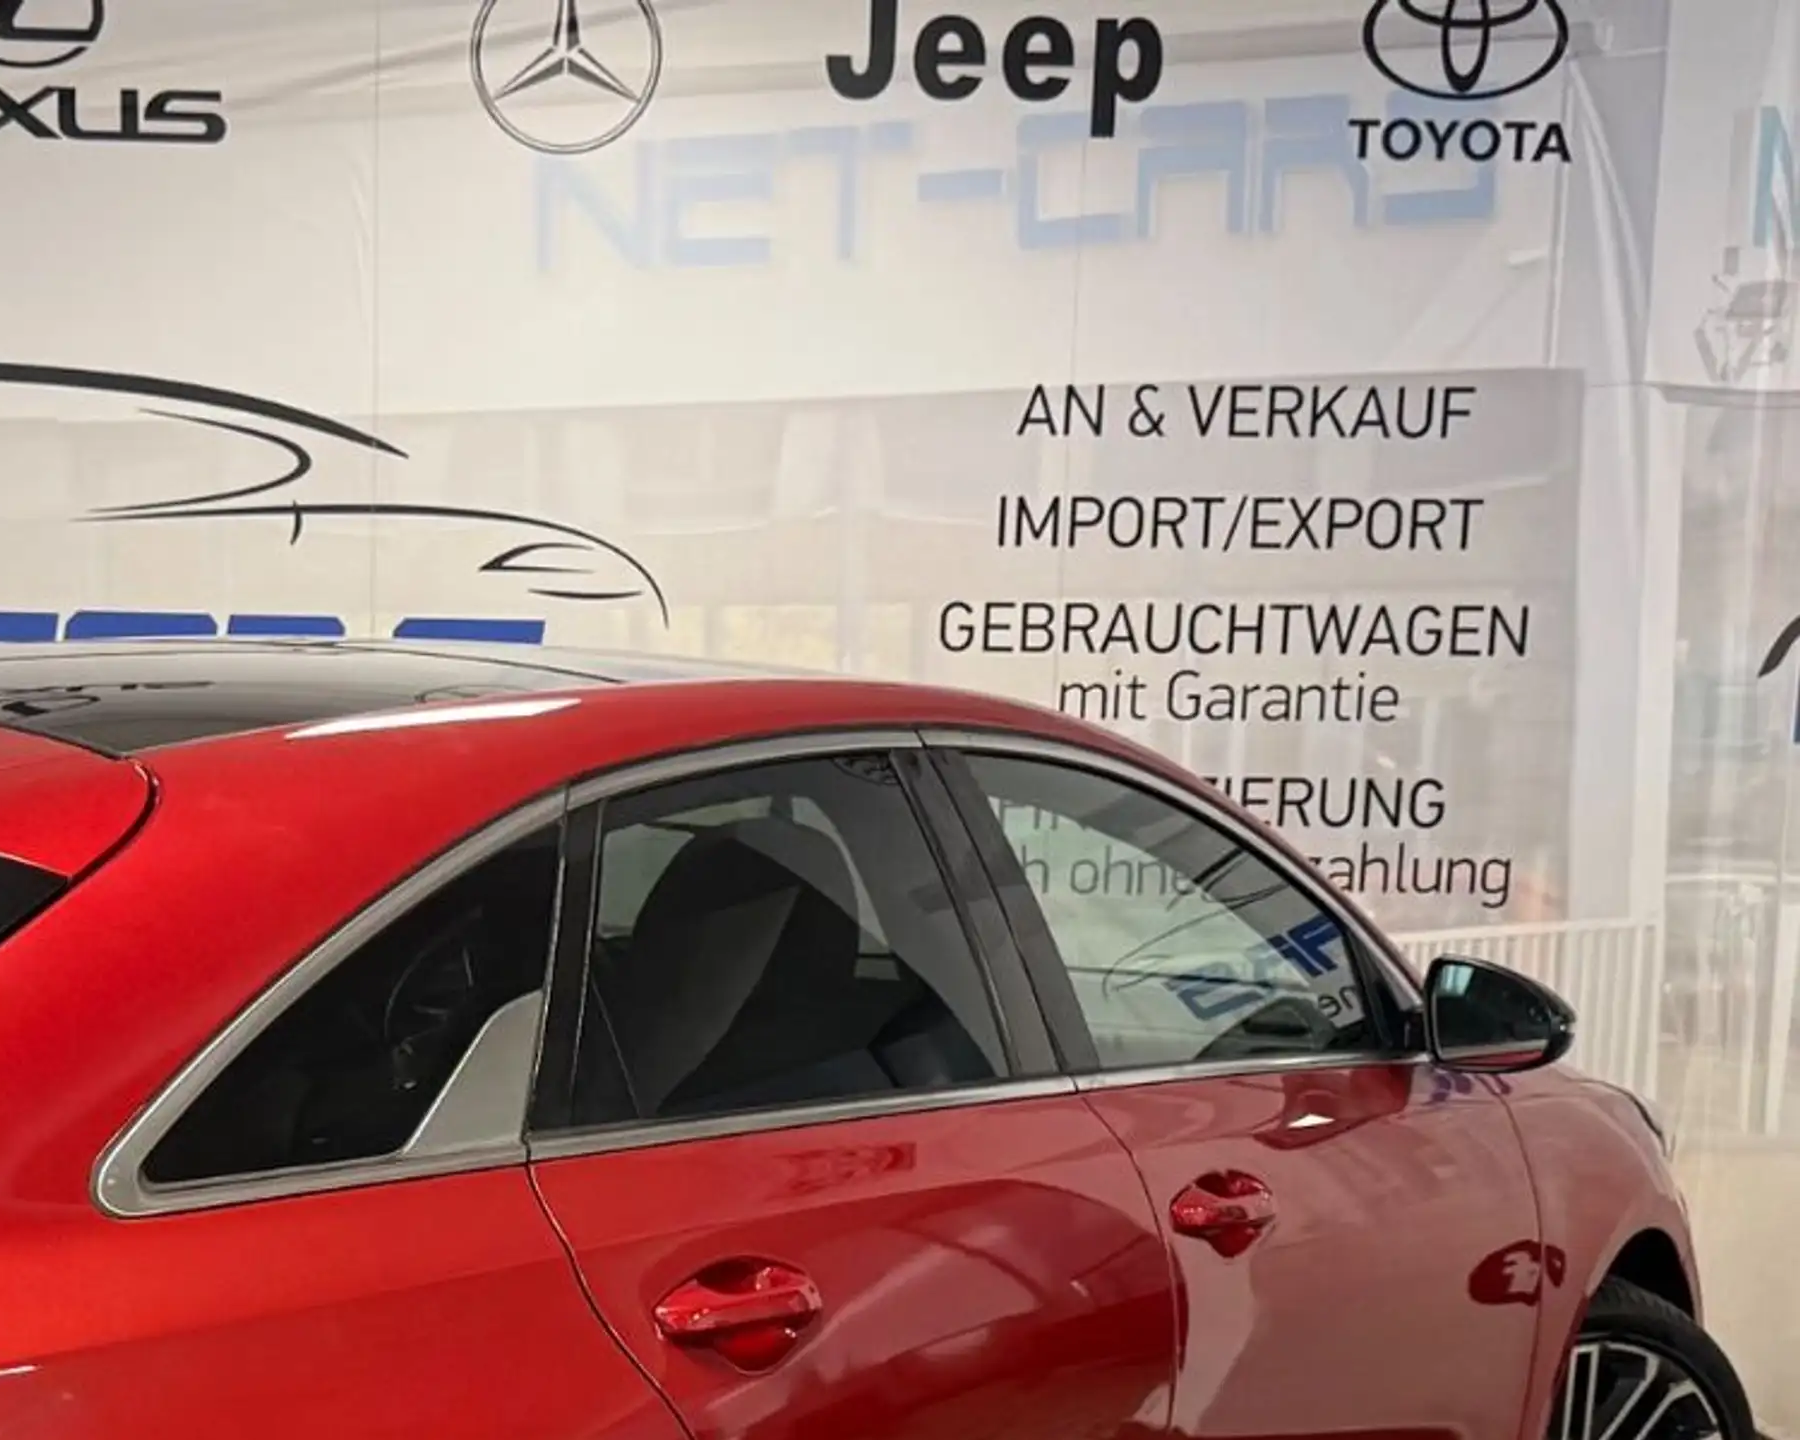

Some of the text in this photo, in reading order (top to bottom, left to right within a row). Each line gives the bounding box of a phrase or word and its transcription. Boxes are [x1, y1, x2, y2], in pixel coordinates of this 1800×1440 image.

[825, 0, 1163, 138] Jeep
[1347, 117, 1572, 163] TOYOTA
[1017, 384, 1477, 439] AN & VERKAUF
[998, 495, 1485, 552] IMPORT/EXPORT
[940, 601, 1529, 657] GEBRAUCHTWAGEN
[1059, 670, 1399, 722] mit Garantie
